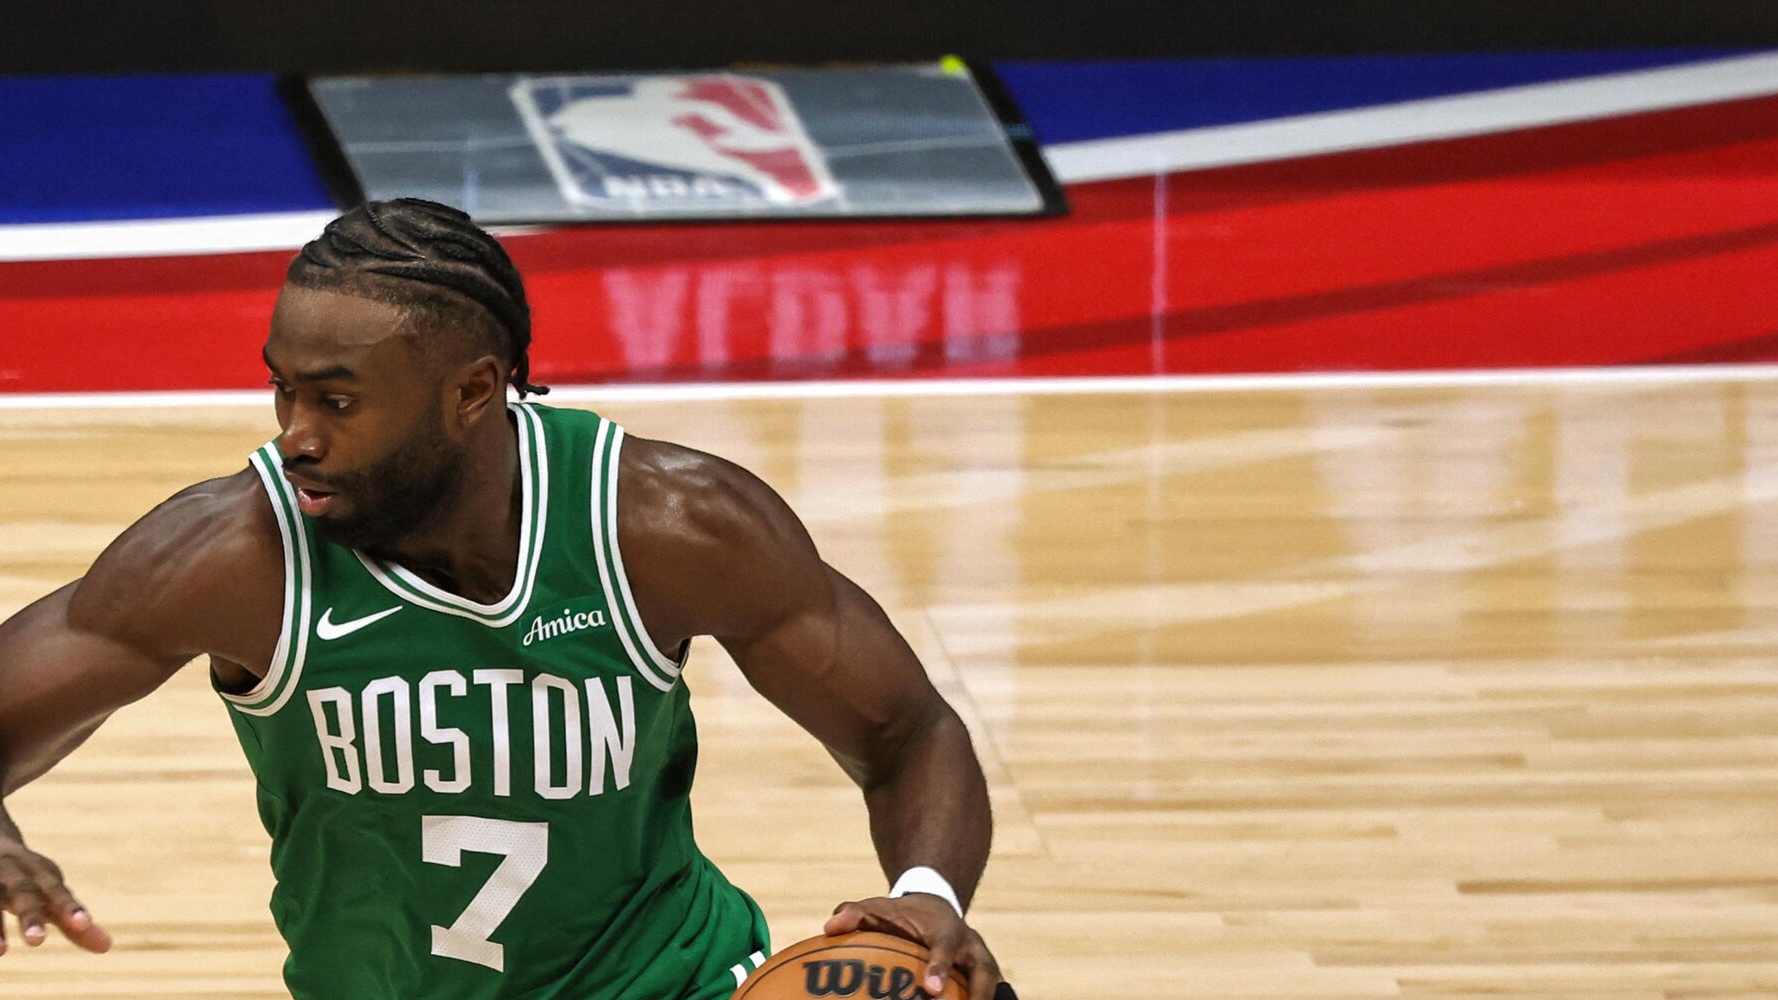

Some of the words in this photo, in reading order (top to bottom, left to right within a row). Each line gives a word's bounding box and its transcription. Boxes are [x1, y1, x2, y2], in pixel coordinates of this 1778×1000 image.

[522, 608, 606, 646] Amica
[306, 669, 636, 800] BOSTON
[421, 814, 549, 973] 7
